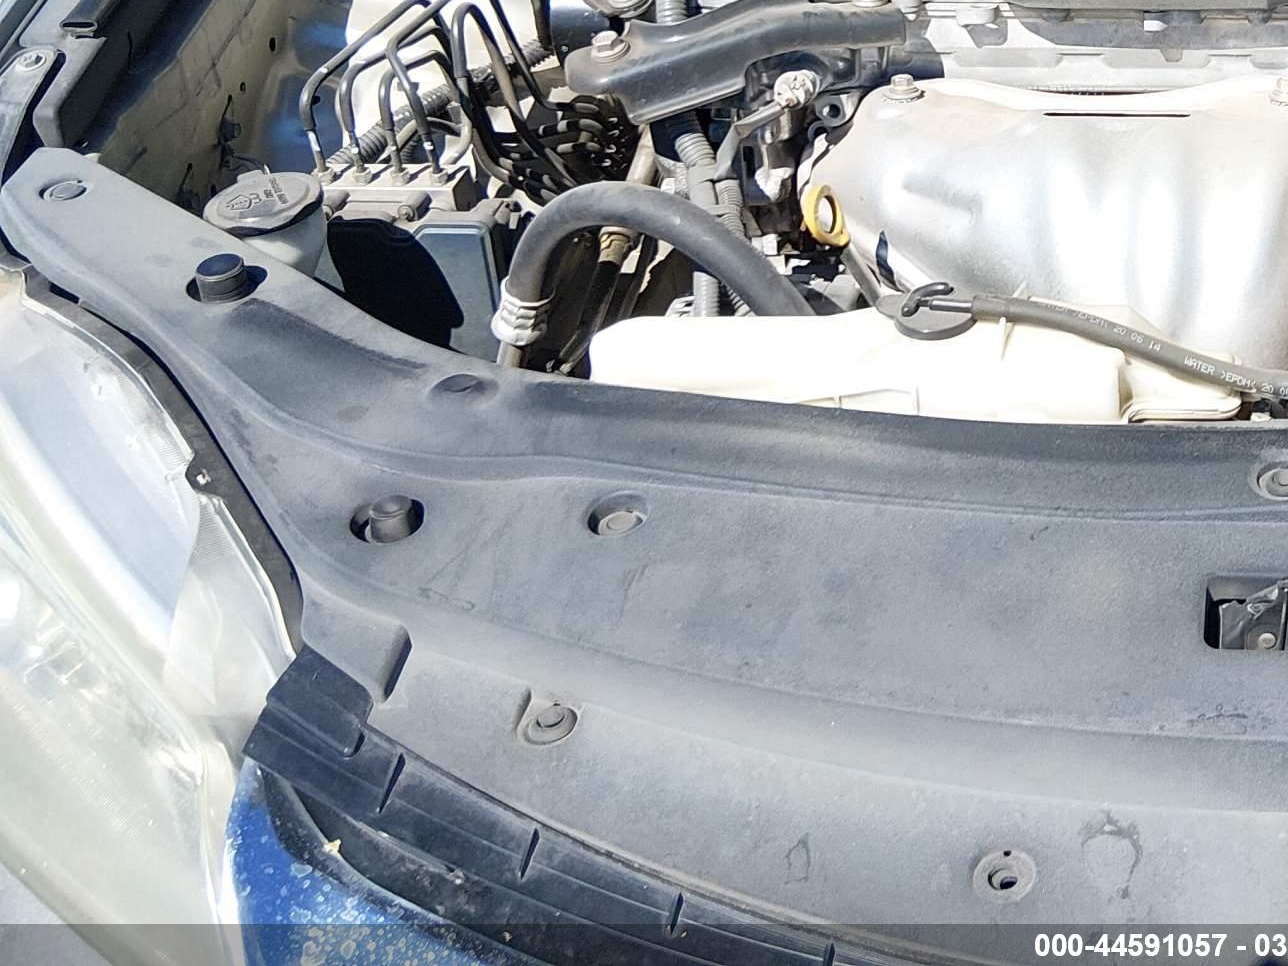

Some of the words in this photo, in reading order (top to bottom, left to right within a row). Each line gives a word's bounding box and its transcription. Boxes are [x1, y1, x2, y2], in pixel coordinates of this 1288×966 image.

[1112, 325, 1127, 335] 20
[1130, 333, 1144, 344] 06
[1183, 354, 1216, 376] WATER
[1261, 382, 1274, 394] 20
